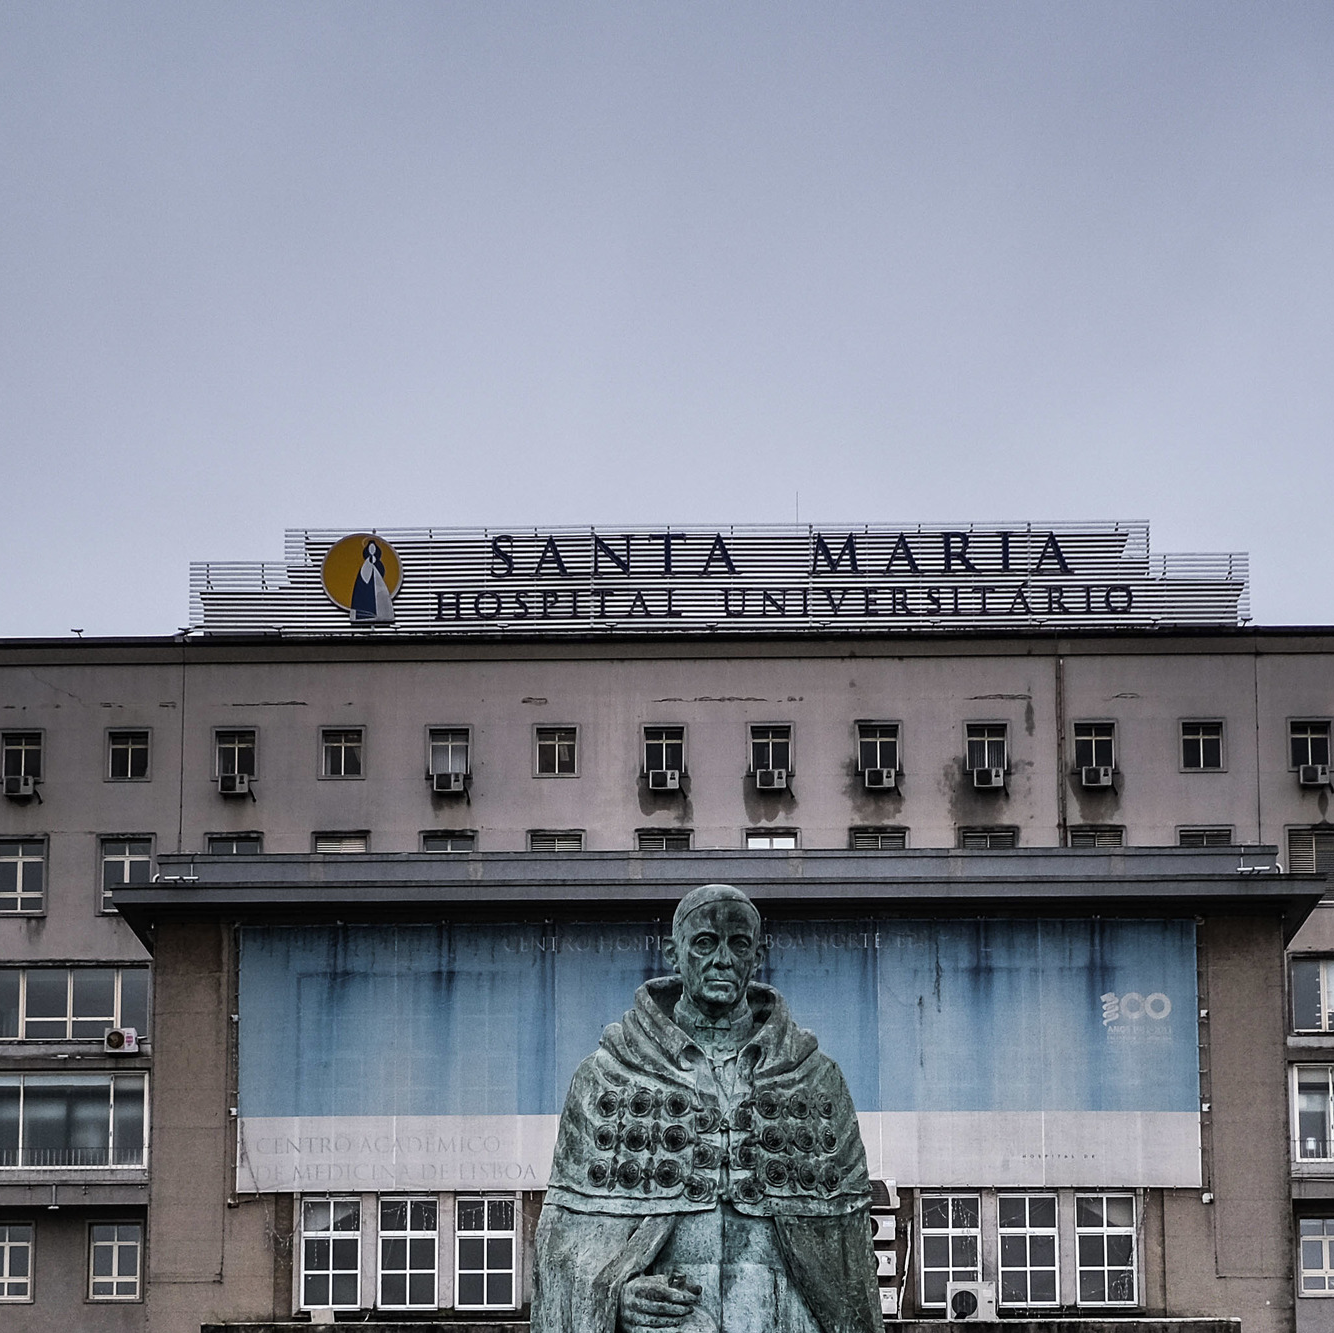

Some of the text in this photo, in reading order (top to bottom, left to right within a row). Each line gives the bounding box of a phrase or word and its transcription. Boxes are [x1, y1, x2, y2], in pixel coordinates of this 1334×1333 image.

[489, 530, 1075, 578] SANTA MARIA
[434, 580, 1134, 620] HOSPITAL UNIVERSITÁRIO
[599, 935, 663, 952] HOSPI
[256, 1136, 352, 1155] CENTRO
[293, 1163, 414, 1182] MEDICINA
[421, 1162, 450, 1181] DE
[459, 1162, 538, 1181] LISBOA
